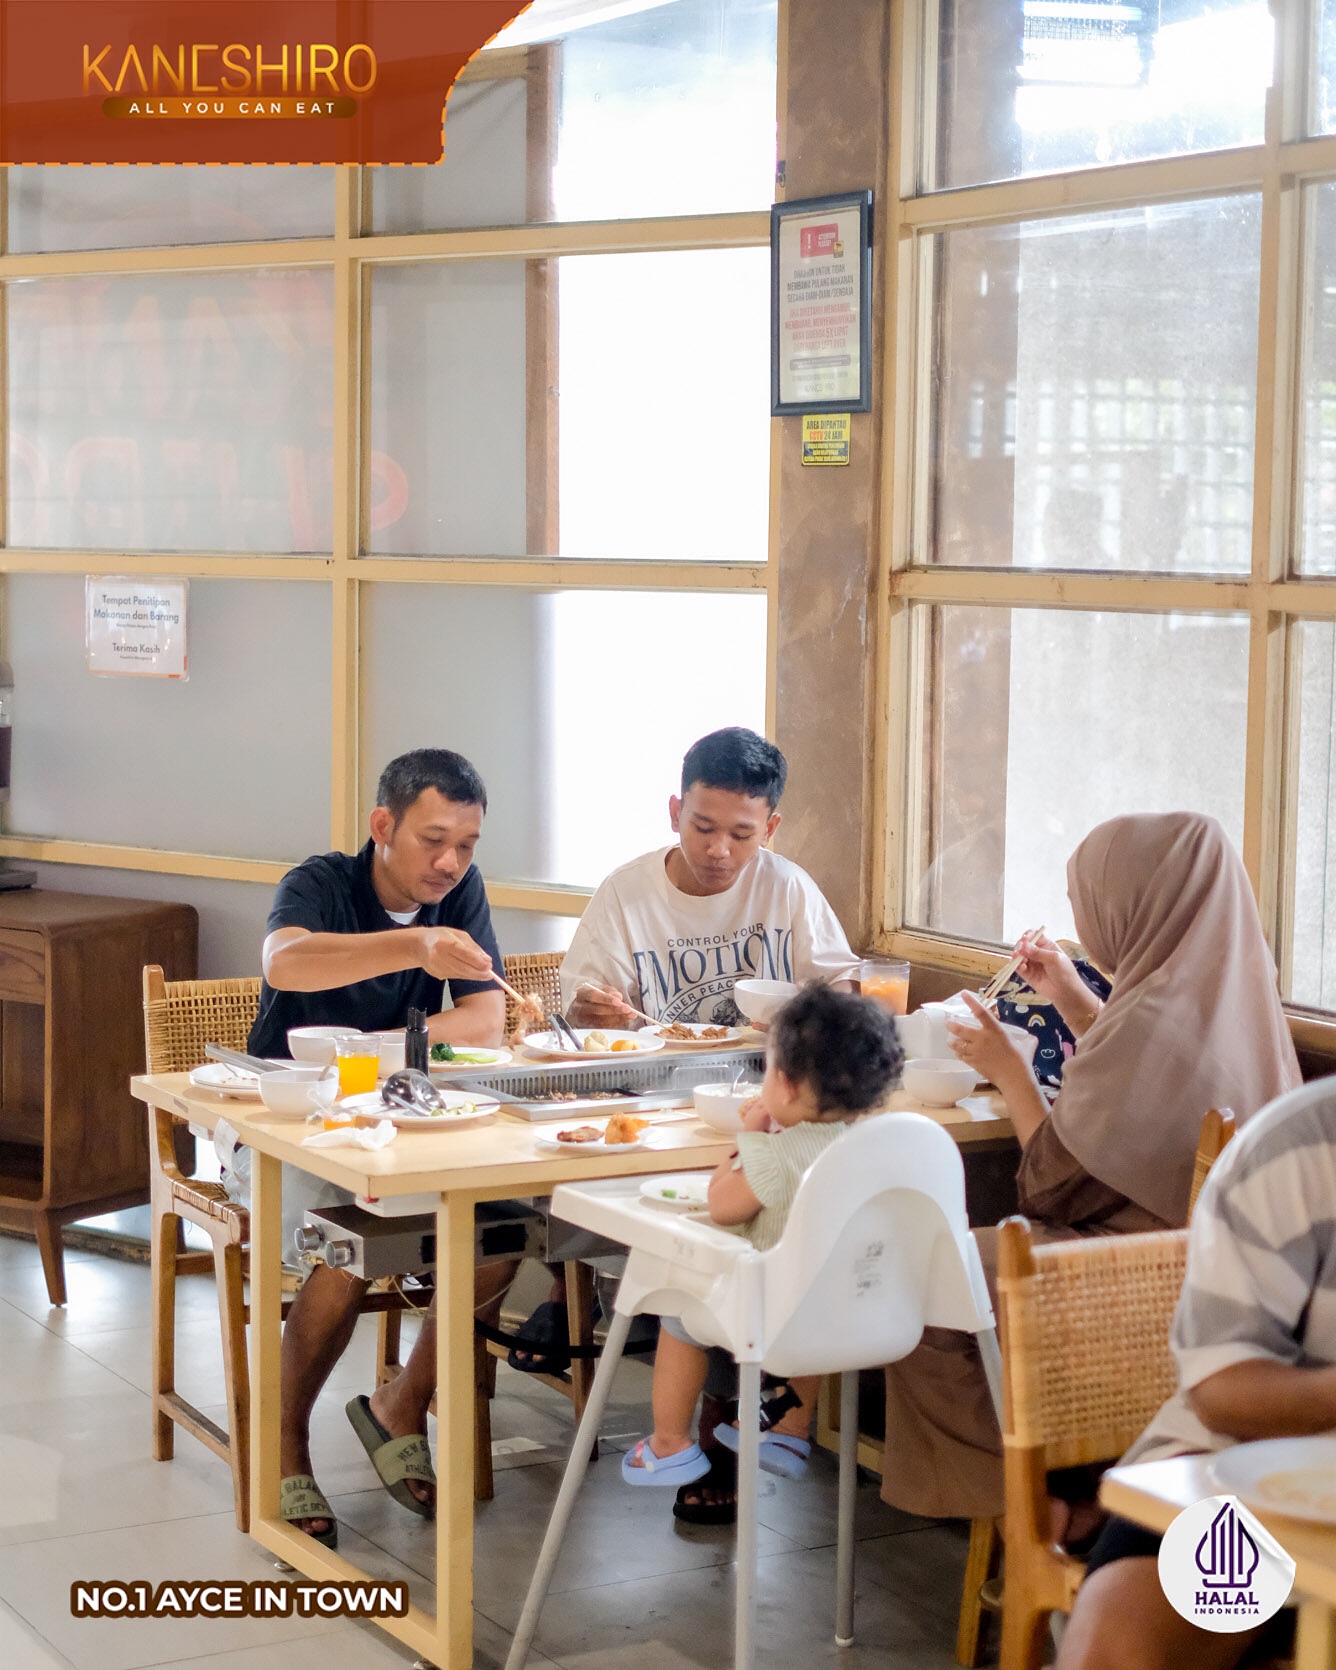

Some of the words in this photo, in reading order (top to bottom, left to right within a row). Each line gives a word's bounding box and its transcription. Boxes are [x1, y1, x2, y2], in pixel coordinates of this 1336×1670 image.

[807, 420, 820, 430] AREA
[820, 419, 847, 430] DIPANTAU
[102, 595, 132, 608] Tempat
[133, 596, 170, 609] Penitipan
[93, 608, 131, 620] Makanan
[132, 610, 149, 621] dan
[150, 611, 179, 624] Barang
[112, 642, 138, 653] Terima
[139, 644, 161, 654] Kasih
[667, 934, 729, 948] CONTROL
[733, 922, 765, 939] YOUR
[664, 993, 697, 1024] INNER
[700, 978, 740, 996] PEAC
